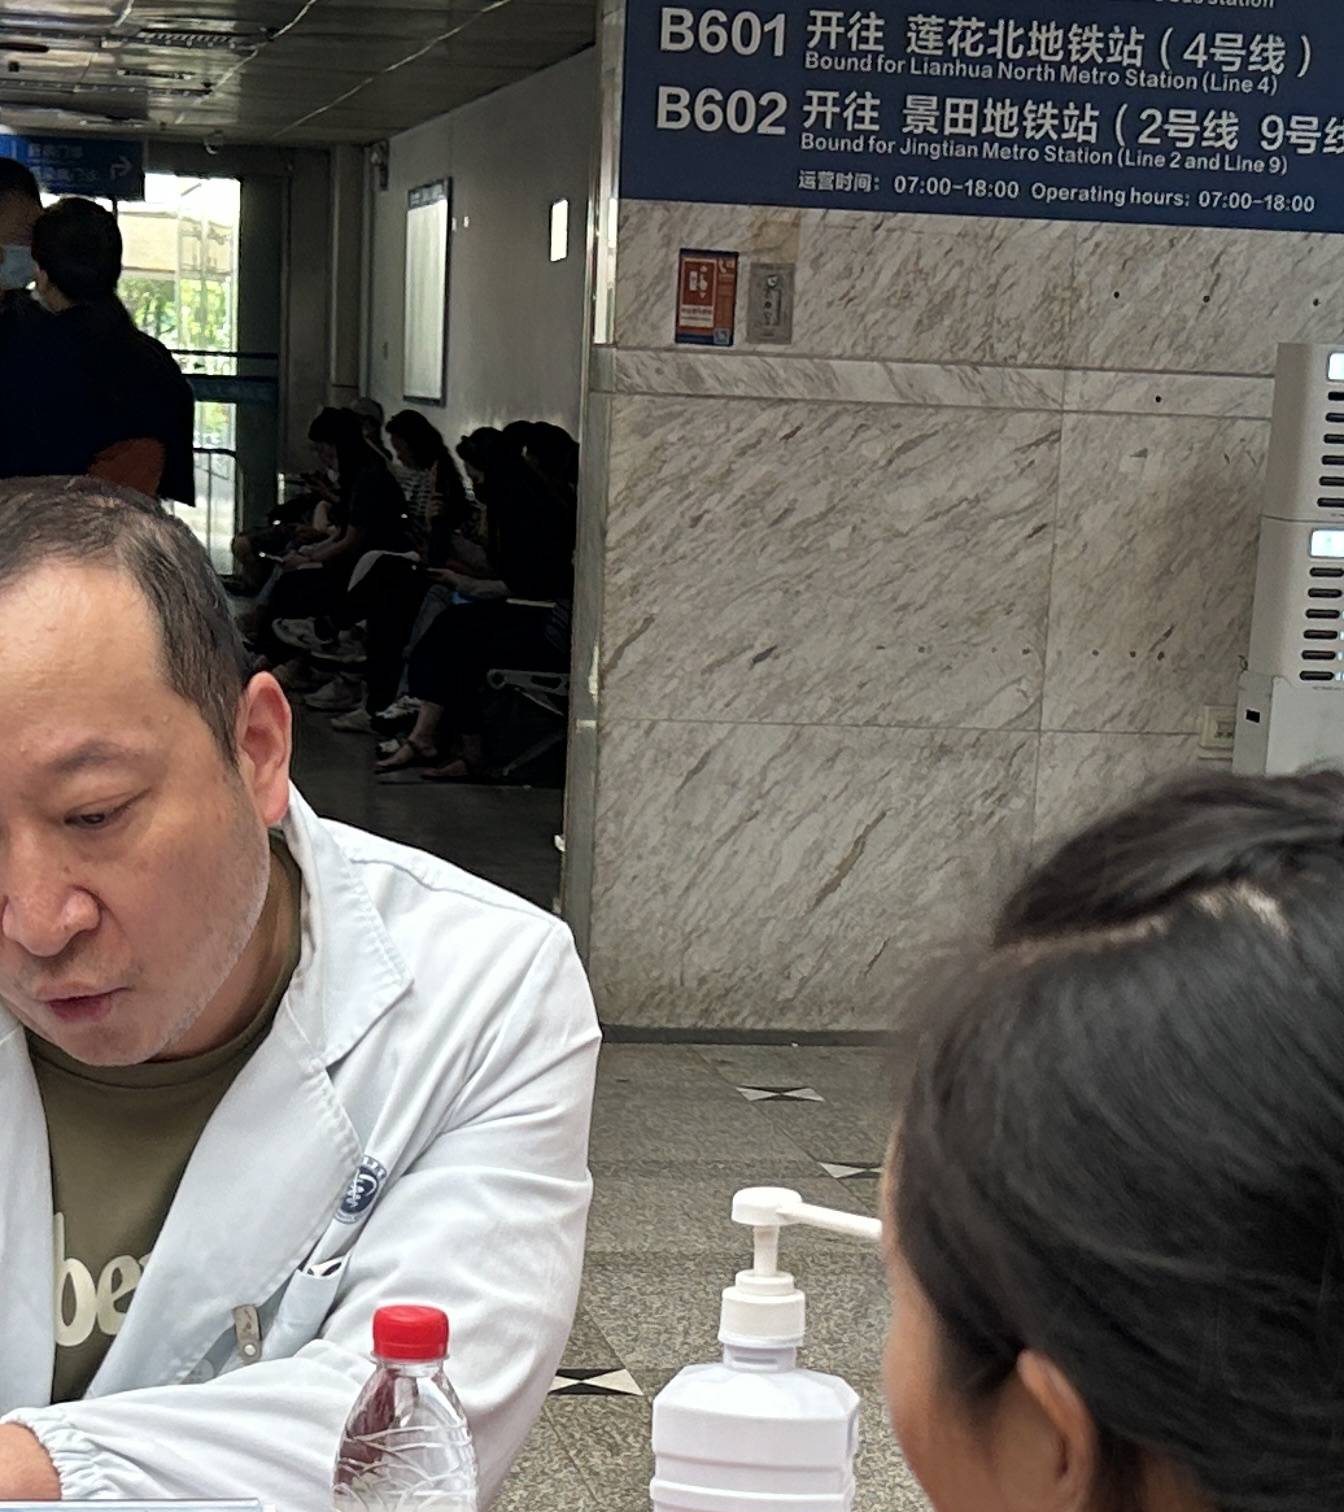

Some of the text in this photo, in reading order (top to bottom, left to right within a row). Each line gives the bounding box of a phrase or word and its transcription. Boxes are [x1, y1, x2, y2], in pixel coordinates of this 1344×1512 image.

[660, 8, 786, 57] B601
[806, 9, 885, 52] 开往
[806, 52, 1278, 96] Bound for Lianhua North Metro Station (Line 4)
[656, 86, 788, 136] B602
[802, 89, 881, 132] 开往
[801, 133, 1288, 176] Bound for Jingtian Metro Station (Line 2 and Line 9)
[894, 174, 1020, 199] 07:00-18:00
[1031, 181, 1126, 207] Operating
[1130, 185, 1190, 207] hours:
[1198, 190, 1315, 213] 07:00-18:00
[54, 1212, 154, 1347] be
